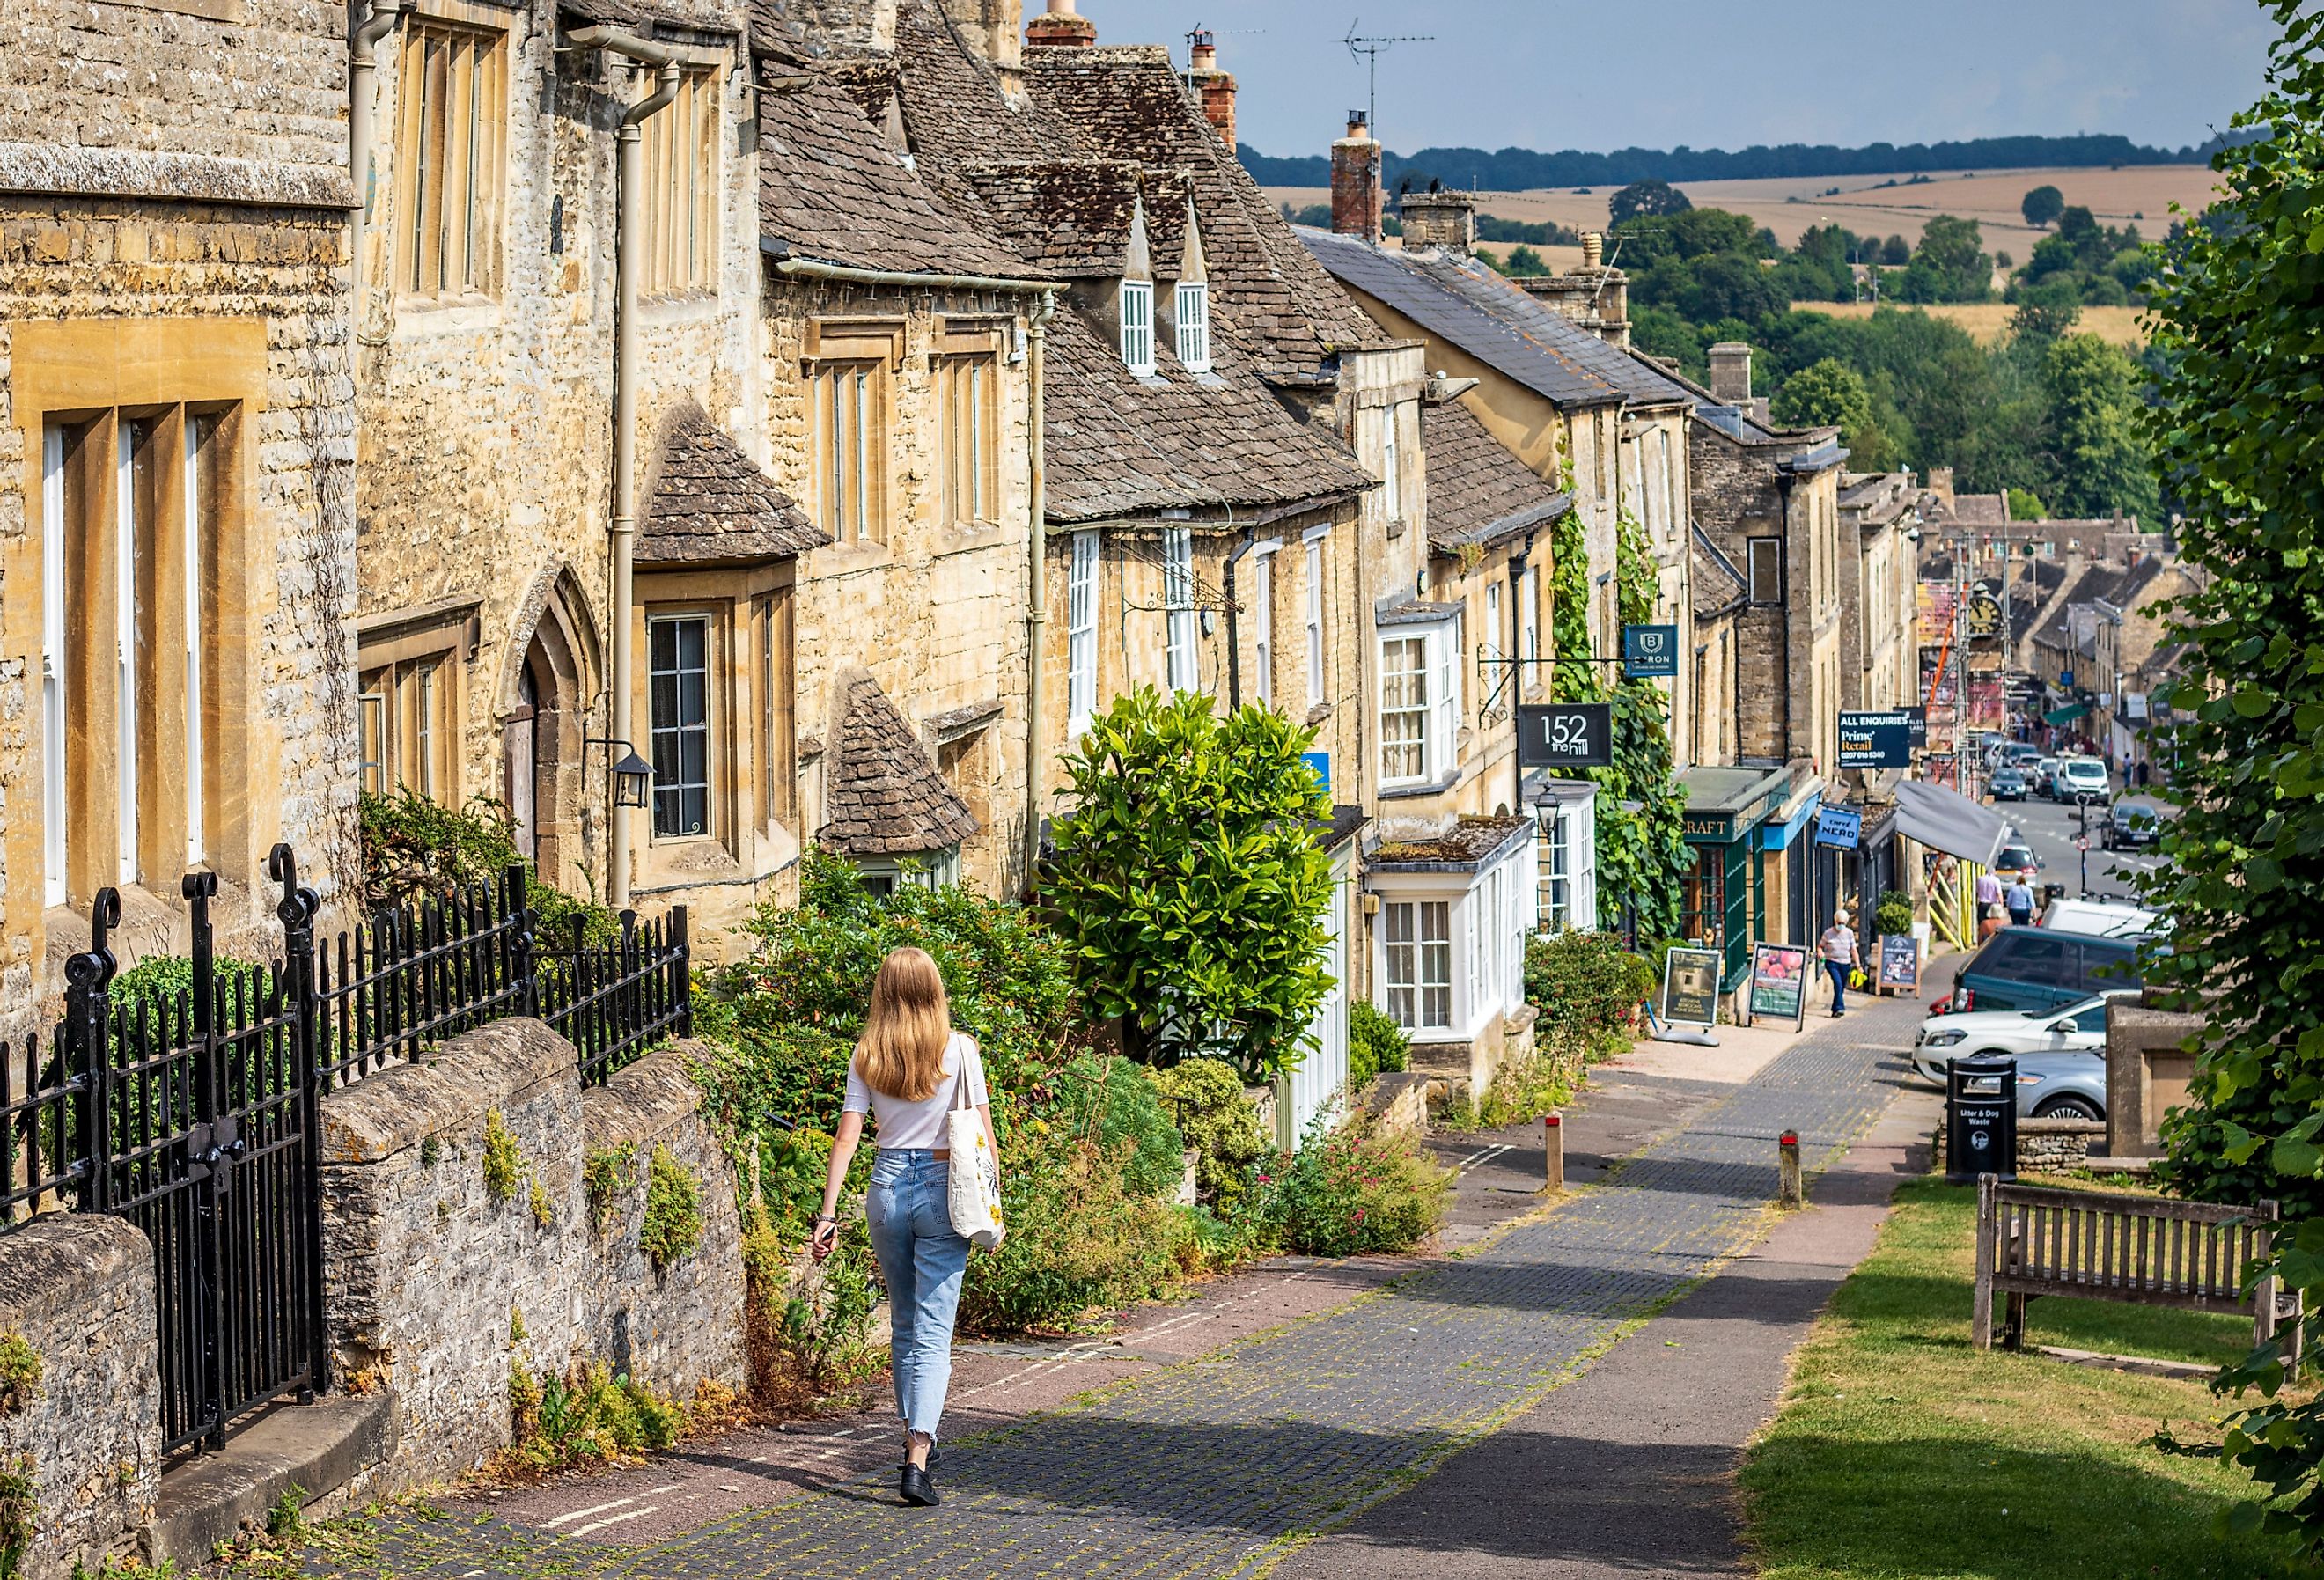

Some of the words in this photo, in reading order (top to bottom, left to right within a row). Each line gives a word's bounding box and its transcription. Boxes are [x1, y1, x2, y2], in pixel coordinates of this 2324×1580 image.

[1841, 717, 1858, 726] ALL
[1859, 716, 1908, 726] ENQUIRIES
[1541, 714, 1587, 744] 152
[1551, 742, 1569, 752] the
[1569, 739, 1588, 755] hill
[1842, 740, 1872, 751] Retail
[1821, 827, 1855, 839] NERO
[1978, 1109, 1984, 1118] &
[1985, 1109, 1999, 1119] Dog
